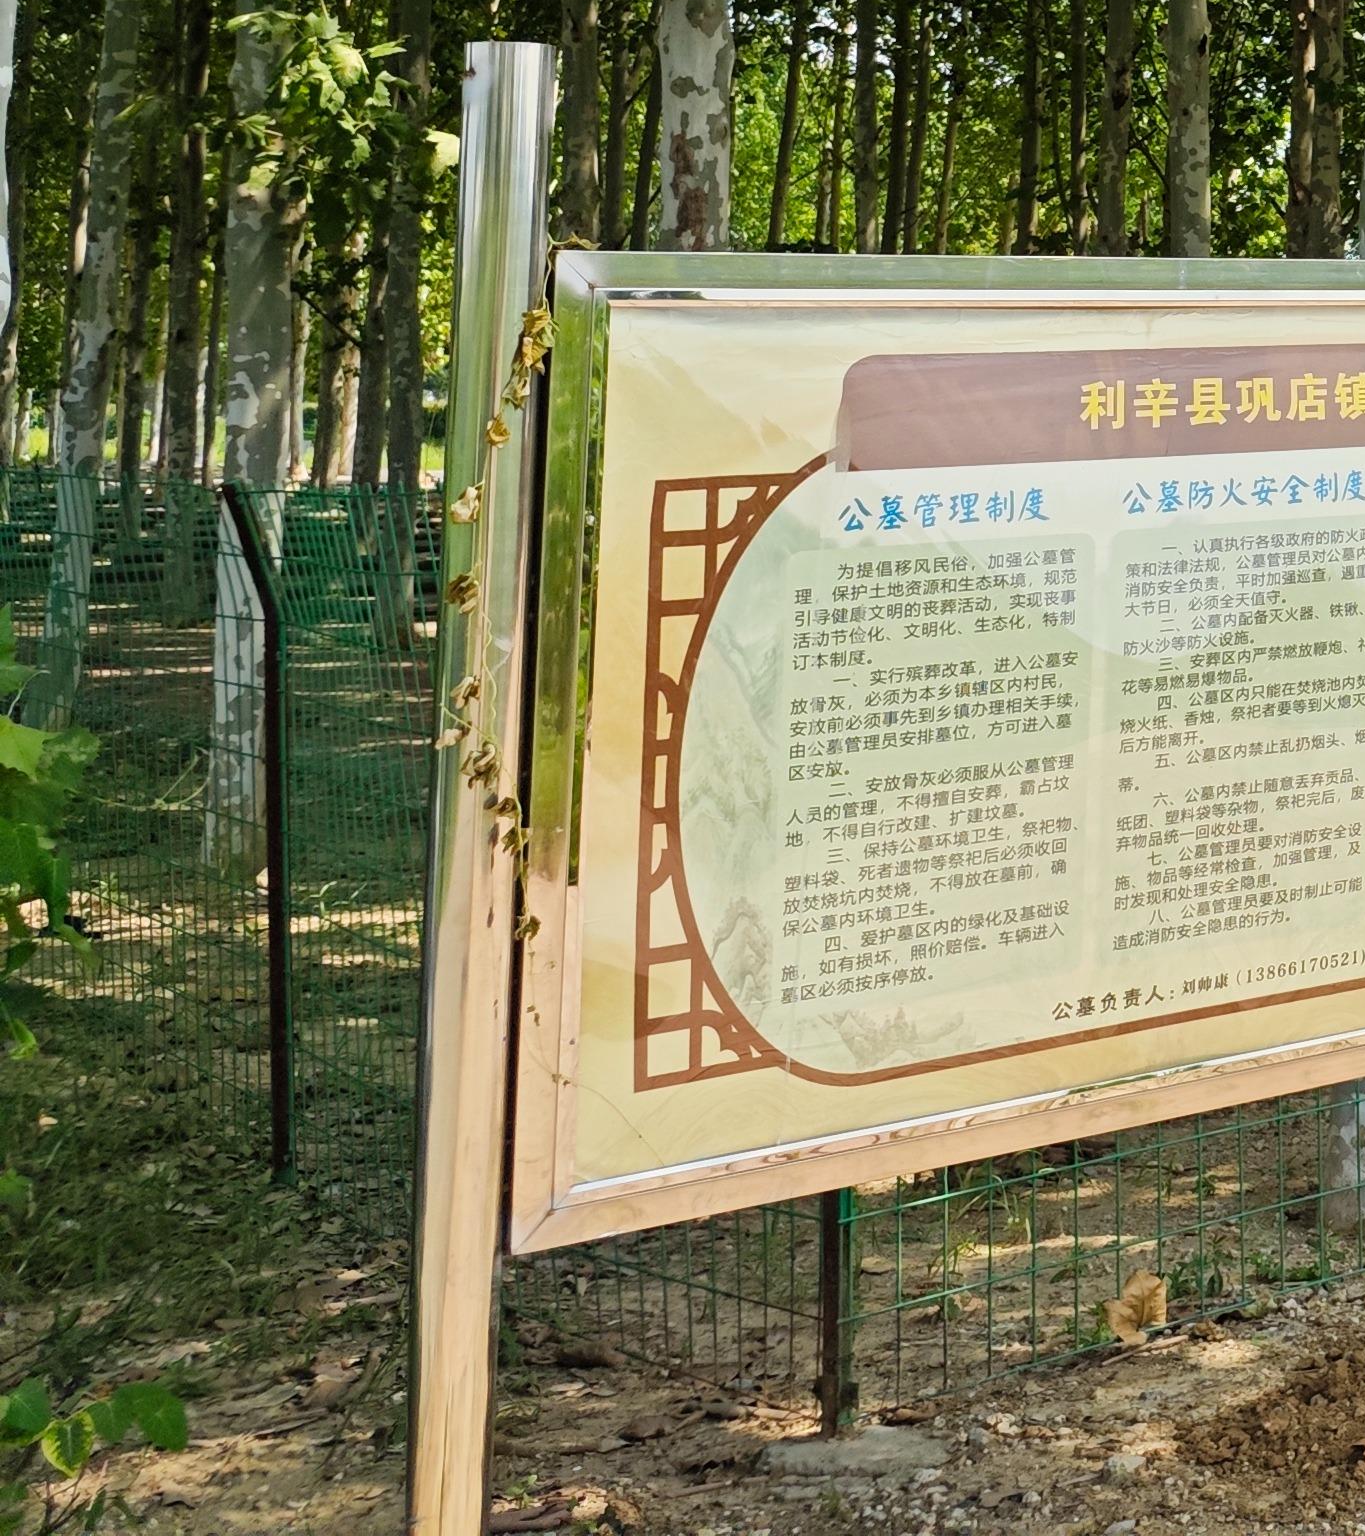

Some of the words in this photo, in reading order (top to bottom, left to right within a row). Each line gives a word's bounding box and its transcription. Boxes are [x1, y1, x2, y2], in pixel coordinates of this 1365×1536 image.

[838, 487, 1050, 531] 公墓管理制度
[793, 650, 873, 670] 订本制度。
[1119, 731, 1204, 754] 后方能离开。
[788, 761, 850, 781] 区安放。
[1116, 818, 1264, 852] 弃物品统一回收处理。
[782, 900, 935, 937] 保公墓内环境卫生。
[781, 967, 934, 1004] 墓区必须按序停放。
